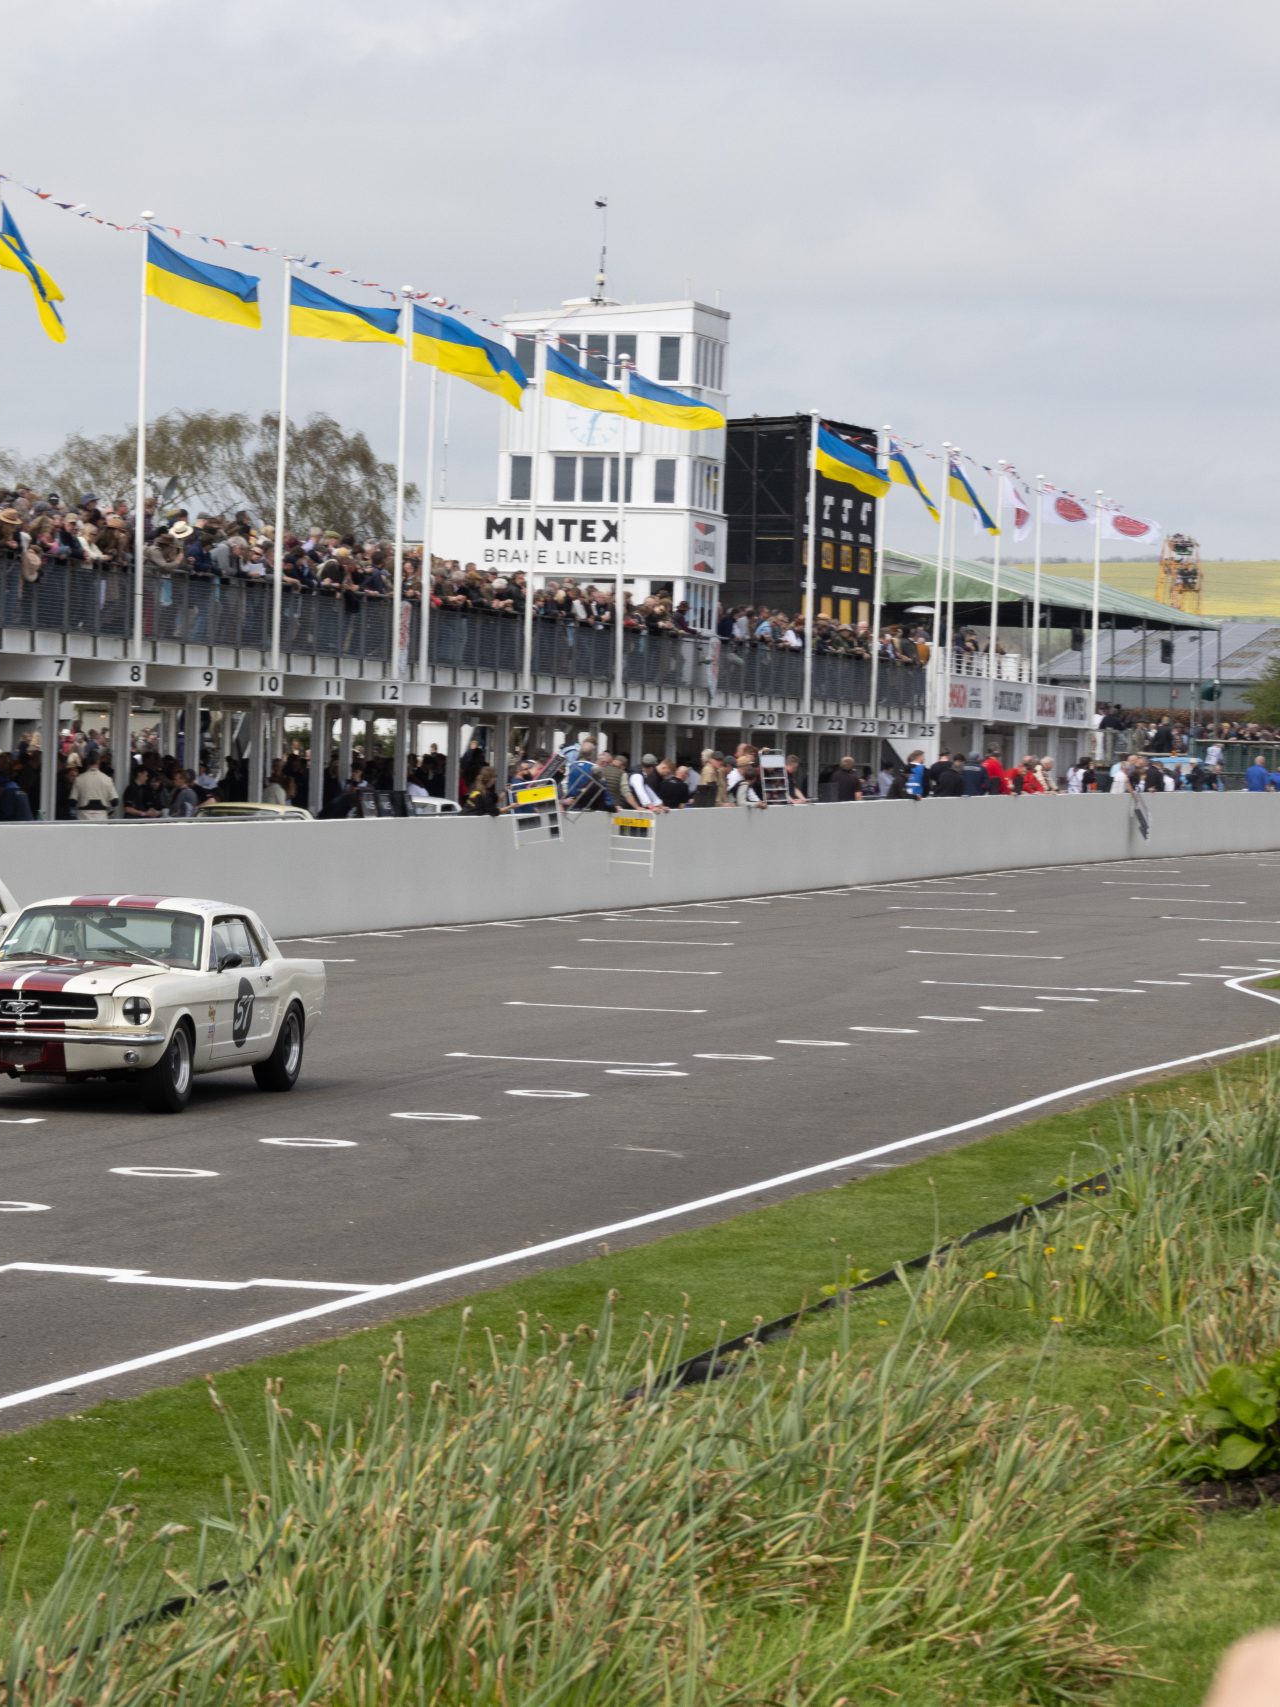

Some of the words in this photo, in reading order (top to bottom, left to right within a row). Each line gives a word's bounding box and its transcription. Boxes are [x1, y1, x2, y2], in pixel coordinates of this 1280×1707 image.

[486, 516, 626, 543] MINTEX
[53, 659, 65, 677] 7
[129, 665, 142, 682] 8
[202, 671, 214, 687] 9
[259, 676, 280, 692] 10
[325, 680, 342, 696] 11
[381, 685, 400, 700] 12
[462, 691, 479, 706] 14
[514, 695, 531, 709] 15
[560, 699, 578, 713] 16
[605, 701, 622, 715] 17
[648, 705, 665, 718] 18
[690, 708, 706, 721] 19
[758, 713, 776, 726] 20
[795, 717, 810, 730] 21
[827, 719, 844, 731] 22
[860, 721, 876, 733] 23
[889, 723, 905, 735] 24
[920, 726, 936, 737] 25
[233, 994, 255, 1031] 57
